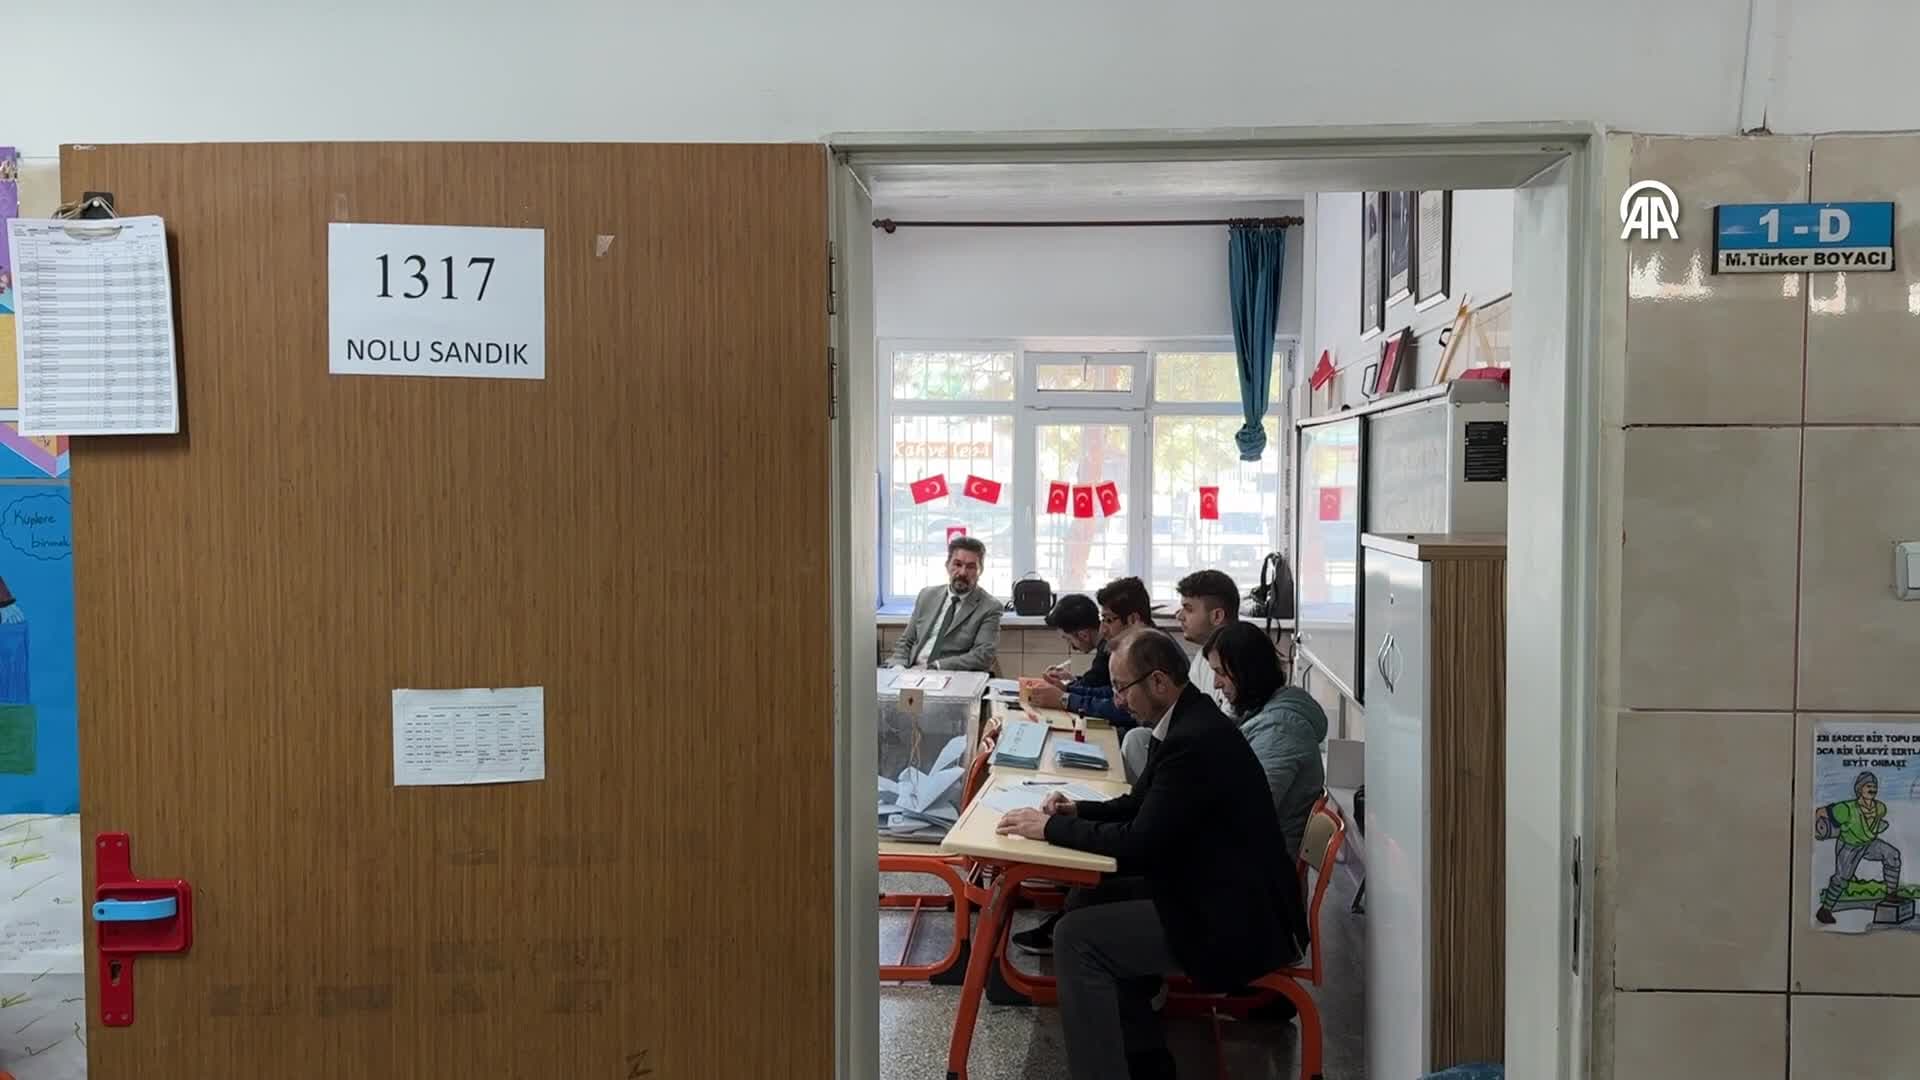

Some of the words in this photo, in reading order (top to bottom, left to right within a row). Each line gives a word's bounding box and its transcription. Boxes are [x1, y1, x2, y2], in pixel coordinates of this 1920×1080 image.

[1724, 251, 1809, 267] M.Türker
[1812, 251, 1887, 266] BOYACI
[375, 253, 496, 302] 1317
[347, 338, 420, 362] NOLU
[429, 340, 529, 365] SANDIK
